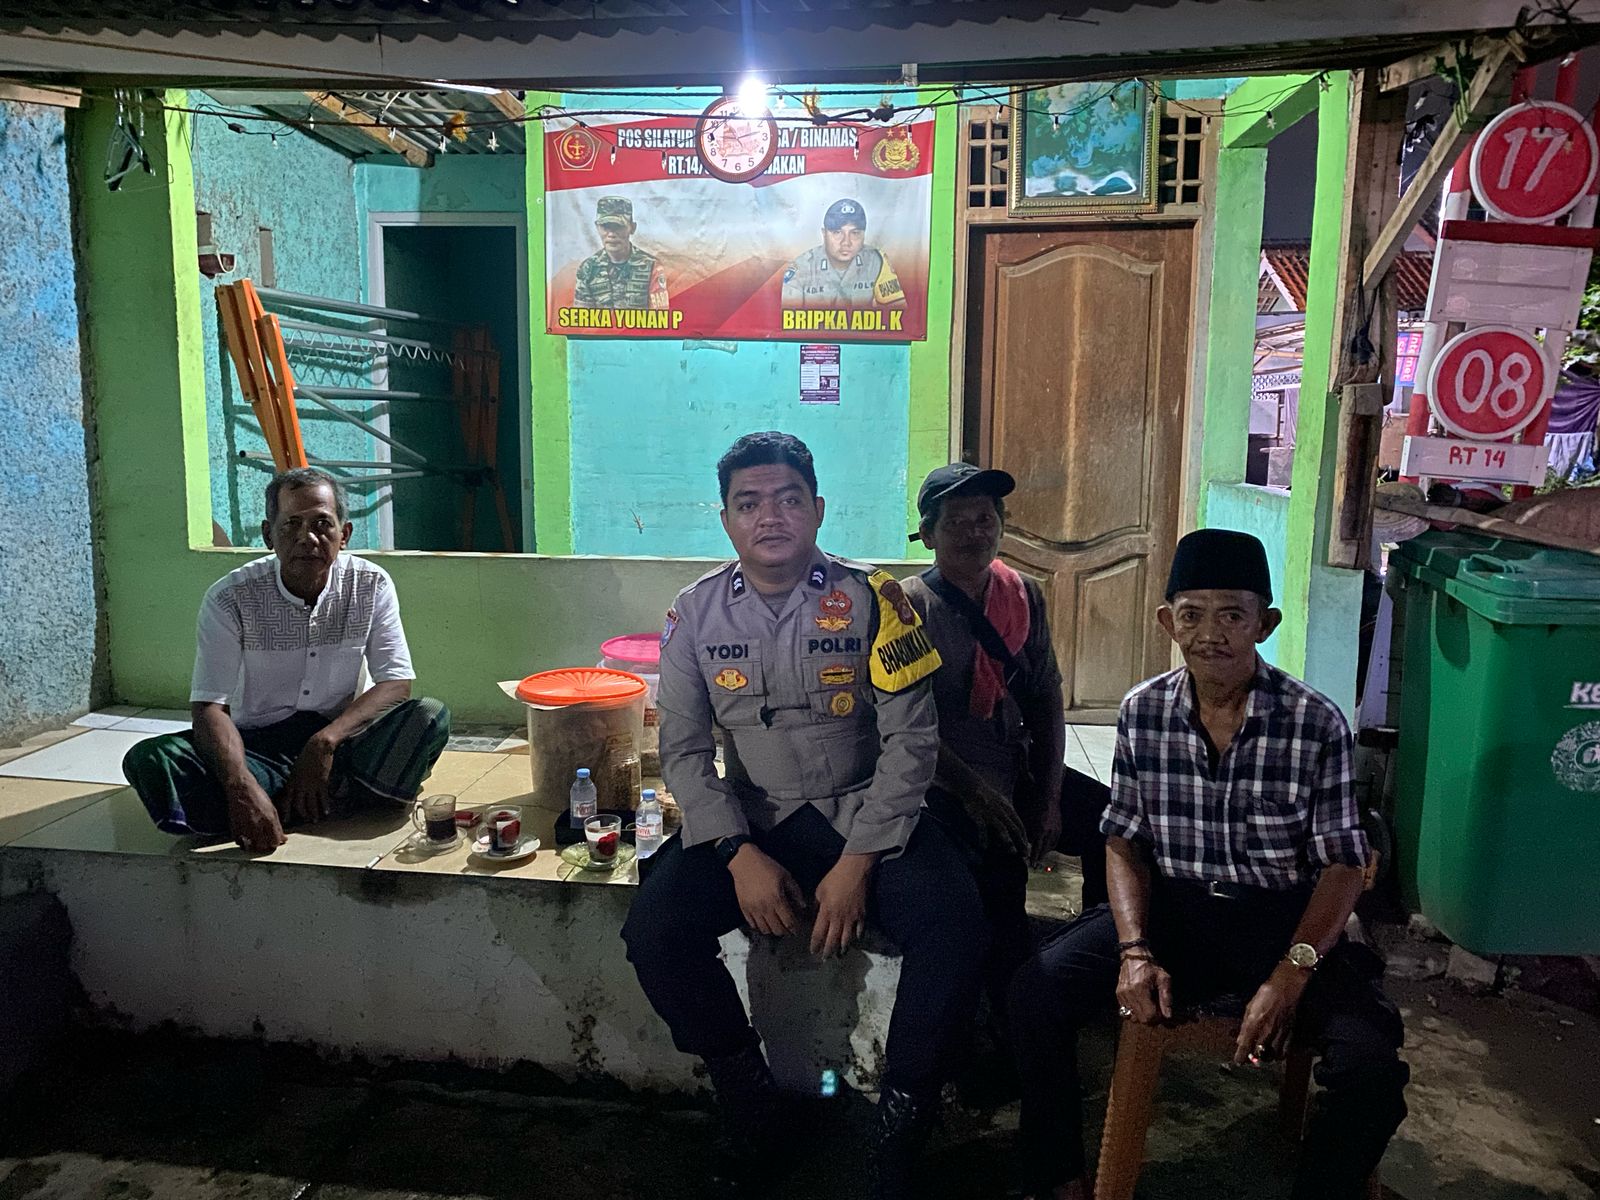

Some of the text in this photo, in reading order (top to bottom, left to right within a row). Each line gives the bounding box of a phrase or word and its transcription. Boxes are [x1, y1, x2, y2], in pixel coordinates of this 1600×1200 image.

[617, 128, 642, 147] POS
[800, 127, 857, 148] BINAMAS
[762, 132, 769, 140] 3
[710, 148, 717, 156] 8
[758, 146, 765, 155] 4
[668, 155, 710, 175] RT.14/
[721, 158, 728, 168] 7
[734, 162, 742, 171] 6
[748, 157, 755, 167] 5
[1498, 127, 1569, 192] 17
[559, 307, 683, 329] SERKA YUNAN P
[782, 309, 903, 331] BRIPKA ADI. K
[1455, 349, 1532, 419] 08
[1449, 446, 1506, 469] RT 14
[705, 643, 749, 660] YODI
[808, 637, 861, 654] POLRI
